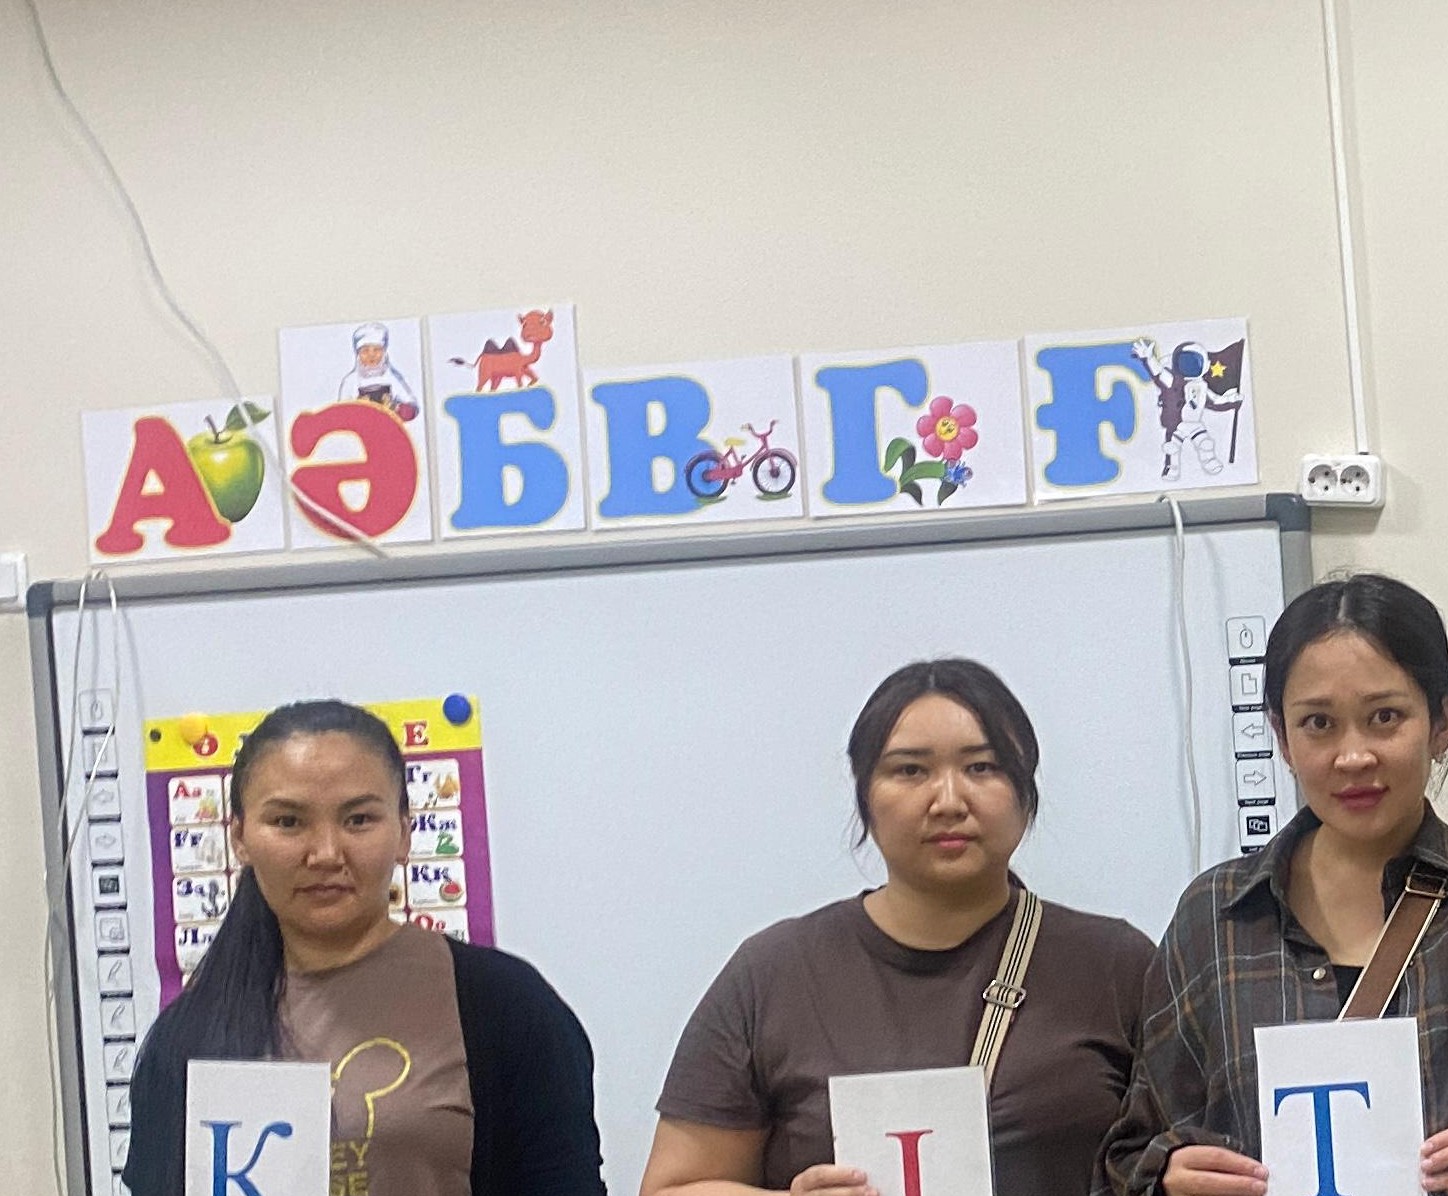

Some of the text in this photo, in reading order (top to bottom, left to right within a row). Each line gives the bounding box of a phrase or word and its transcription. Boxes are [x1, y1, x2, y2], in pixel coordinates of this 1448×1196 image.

[96, 416, 231, 556] А
[291, 401, 418, 540] Ә
[443, 385, 569, 529] Б
[592, 375, 724, 518] В
[815, 358, 929, 507] Г
